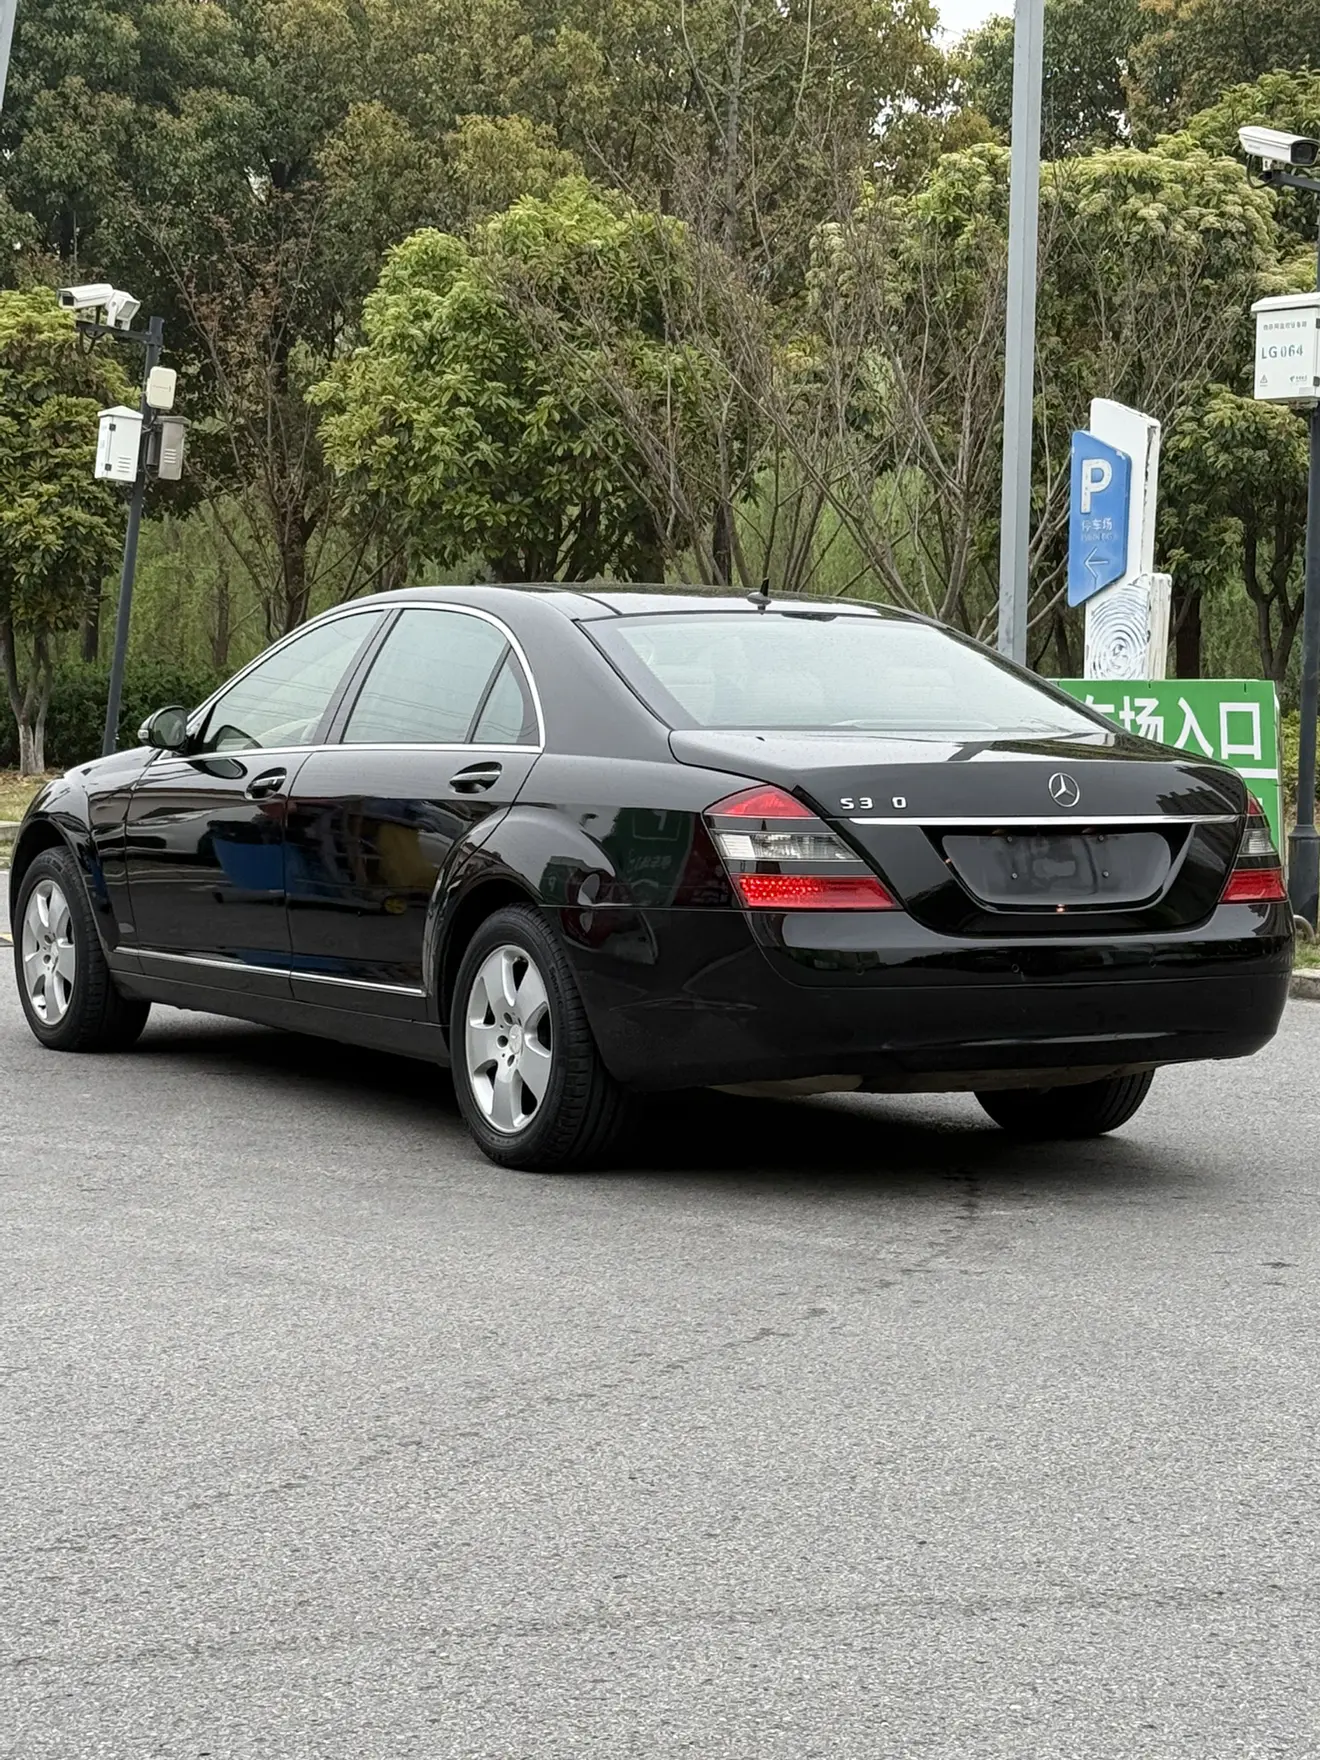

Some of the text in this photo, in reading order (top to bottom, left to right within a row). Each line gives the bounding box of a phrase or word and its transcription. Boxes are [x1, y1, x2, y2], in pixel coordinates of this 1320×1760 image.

[1081, 458, 1113, 514] P
[1081, 516, 1112, 532] 停车场
